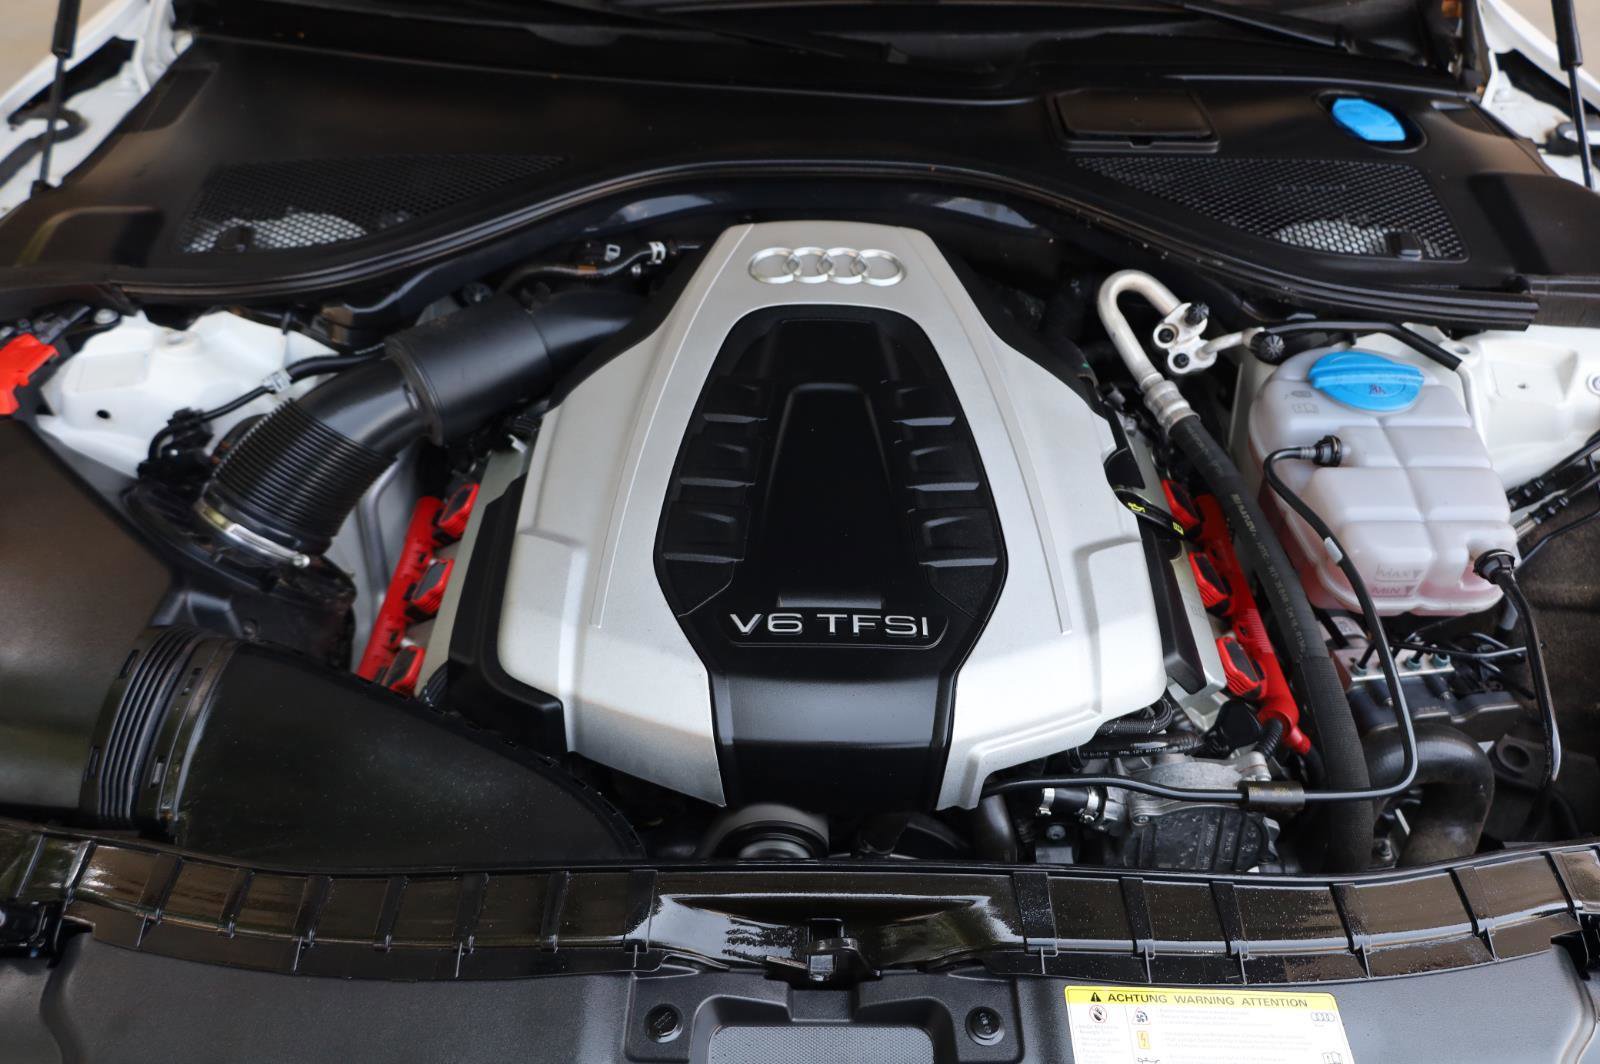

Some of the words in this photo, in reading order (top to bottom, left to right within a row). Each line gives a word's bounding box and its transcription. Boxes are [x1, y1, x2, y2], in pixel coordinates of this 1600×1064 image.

[730, 613, 803, 634] V6
[816, 614, 929, 637] TFSI
[1107, 993, 1168, 1004] ACHTUNG
[1174, 995, 1235, 1006] WARNING
[1241, 997, 1308, 1008] ATTENTION
